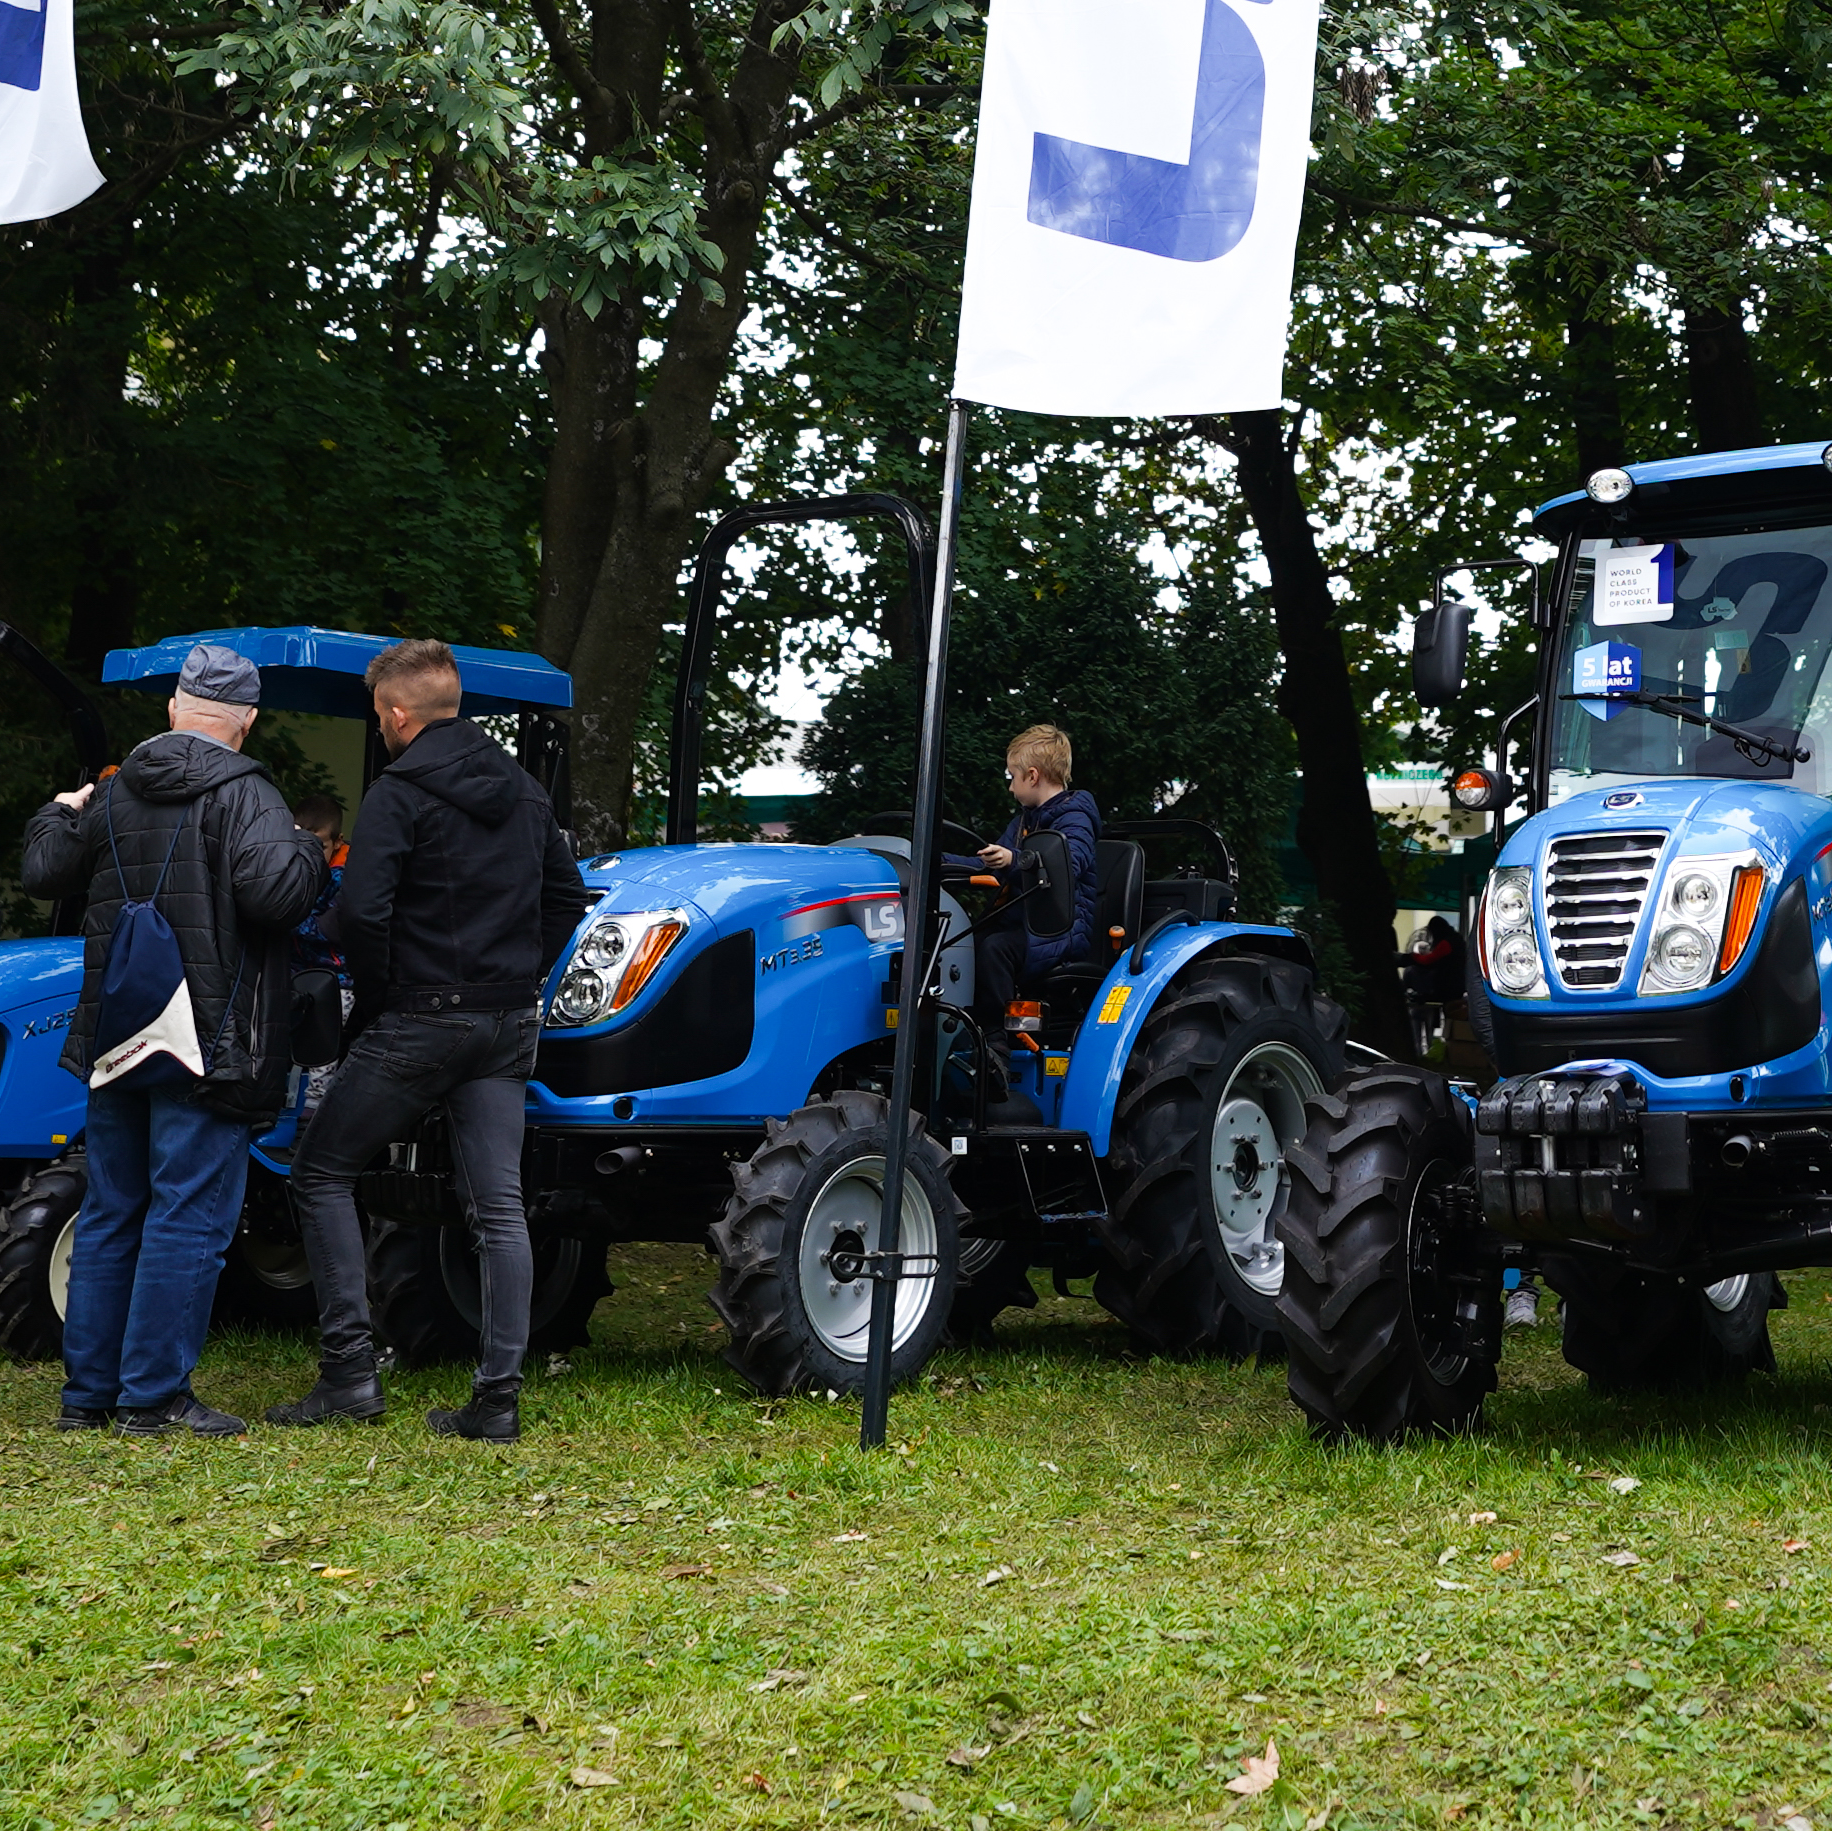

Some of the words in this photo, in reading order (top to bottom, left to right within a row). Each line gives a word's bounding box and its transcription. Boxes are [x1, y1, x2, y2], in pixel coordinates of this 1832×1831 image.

[1610, 568, 1642, 577] WORLD
[1610, 579, 1638, 587] CLASS
[1609, 588, 1651, 598] PRODUCT
[1609, 600, 1621, 608] OF
[1623, 598, 1653, 607] KOREA
[1581, 657, 1596, 677] 5
[1602, 655, 1633, 676] lat
[1581, 677, 1633, 688] GWARANCJI
[864, 905, 897, 939] LS
[760, 936, 824, 976] MT3.35
